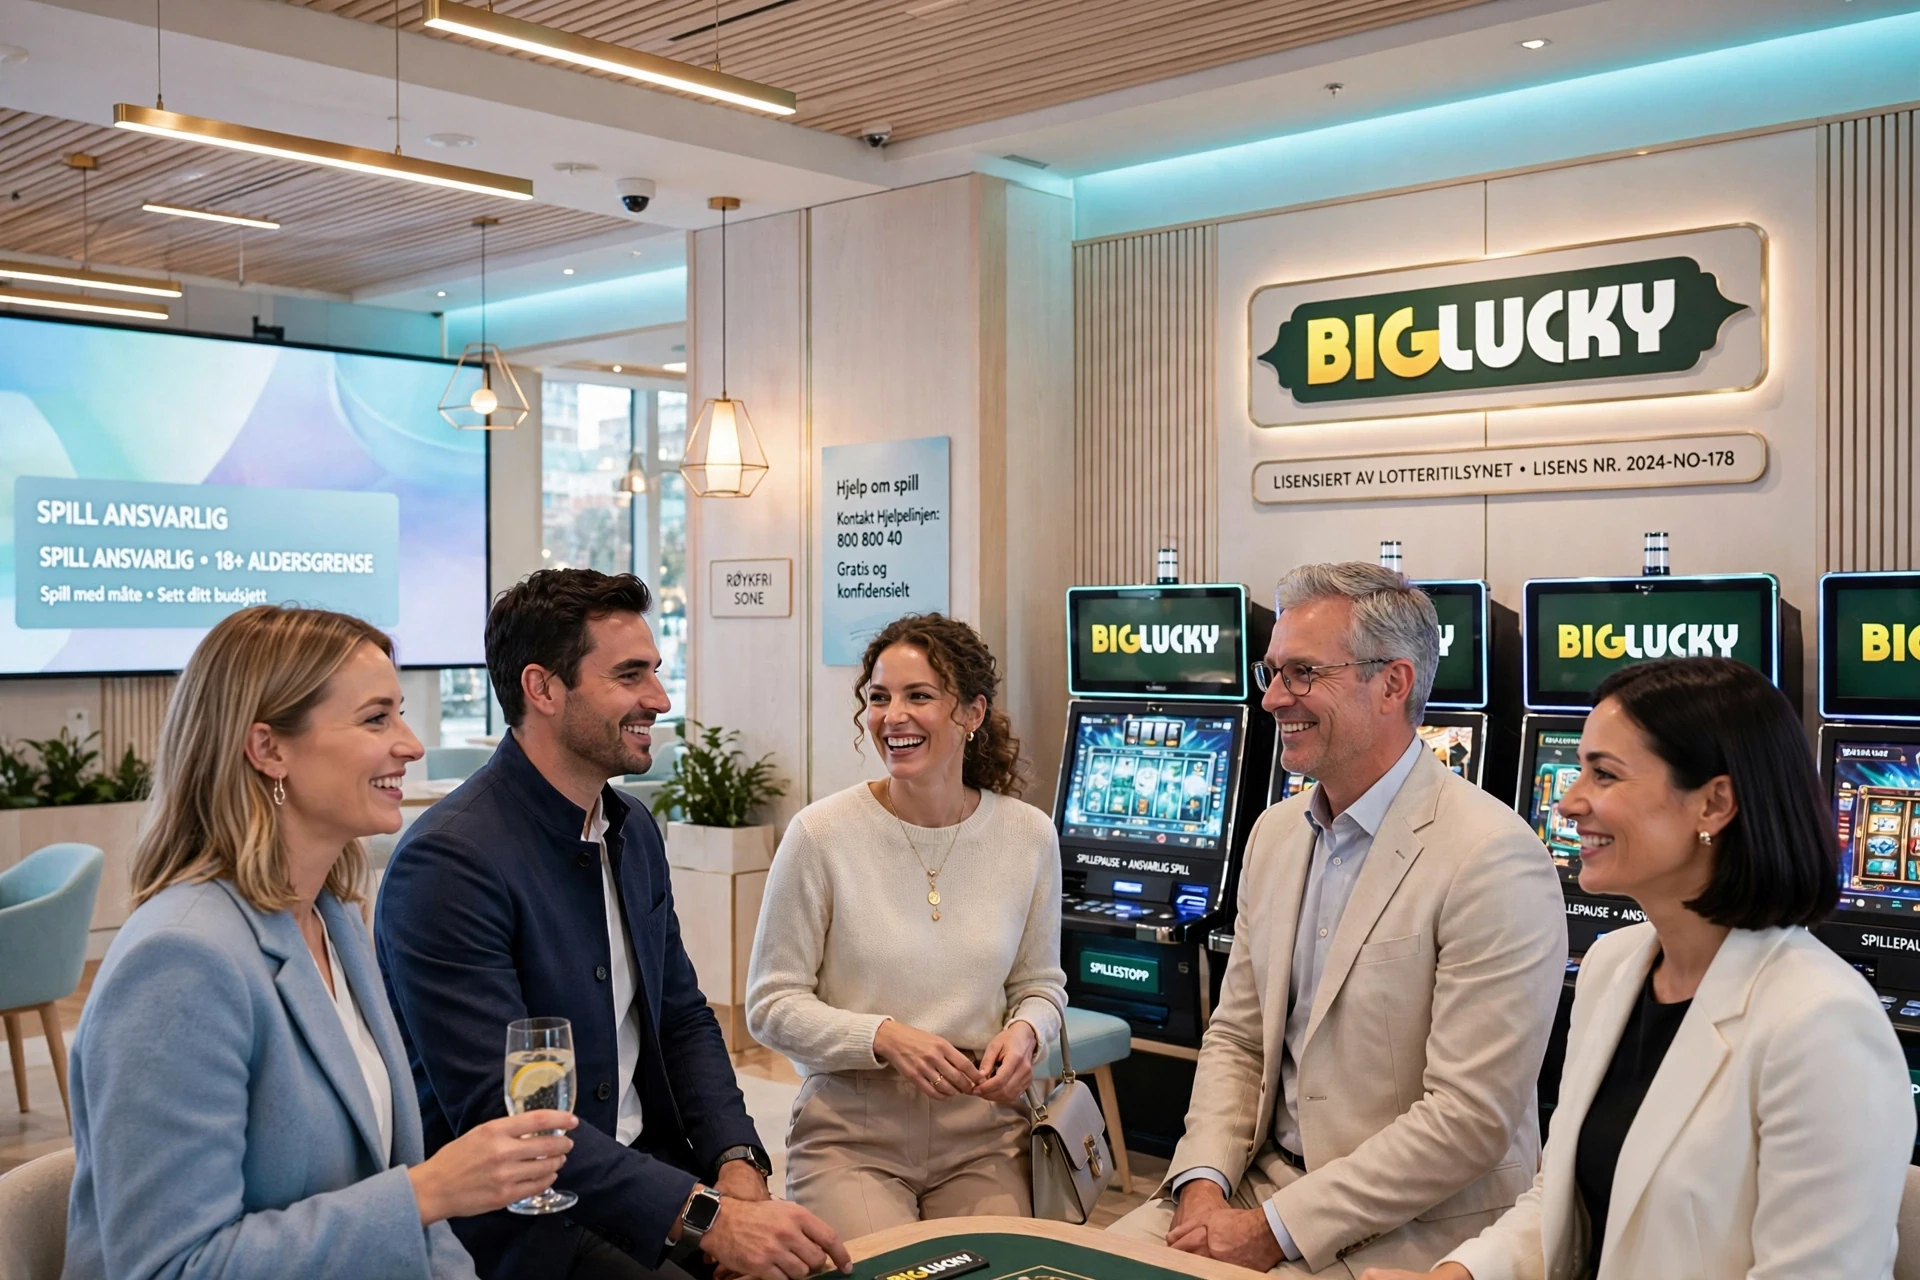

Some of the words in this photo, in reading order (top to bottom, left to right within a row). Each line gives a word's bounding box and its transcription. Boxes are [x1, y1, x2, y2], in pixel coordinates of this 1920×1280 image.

[1307, 278, 1676, 385] BIGLUCKY
[1273, 471, 1352, 490] LISENSIERT
[1355, 470, 1375, 485] AV
[1379, 463, 1513, 484] LOTTERITILSYNET
[1533, 458, 1588, 476] LISENS
[1593, 457, 1621, 473] NR.
[1626, 450, 1735, 471] 2024-NO-178
[836, 478, 868, 501] Hjelp
[870, 481, 891, 494] om
[893, 473, 919, 497] spill
[37, 499, 99, 526] SPILL
[102, 503, 229, 531] ANSVARLIG
[837, 510, 875, 526] Kontakt
[877, 506, 940, 528] Hjelpelinjen:
[837, 532, 859, 548] 800
[861, 530, 884, 547] 800
[886, 529, 903, 546] 40
[39, 546, 90, 568] SPILL
[92, 547, 195, 570] ANSVARLIG
[214, 550, 245, 571] 18+
[247, 551, 374, 574] ALDERSGRENSE
[837, 560, 870, 577] Gratis
[872, 564, 887, 579] og
[726, 572, 772, 587] RØYKFRI
[837, 581, 910, 599] konfidensielt
[40, 585, 71, 606] Spill
[73, 585, 105, 602] med
[107, 585, 143, 602] måte
[157, 586, 185, 603] Sett
[186, 586, 212, 603] ditt
[213, 586, 267, 607] budsjett
[734, 591, 765, 606] SONE
[1091, 624, 1220, 654] BIGLUCKY
[1558, 623, 1739, 659] BIGLUCKY
[1076, 853, 1121, 868] SPILLEPAUSE
[1127, 859, 1170, 873] ANSVARLIG
[1170, 863, 1190, 876] SPILL
[1566, 903, 1610, 919] LEPAUSE
[1621, 909, 1650, 922] ANSV
[1090, 961, 1150, 982] SPILLESTOPP
